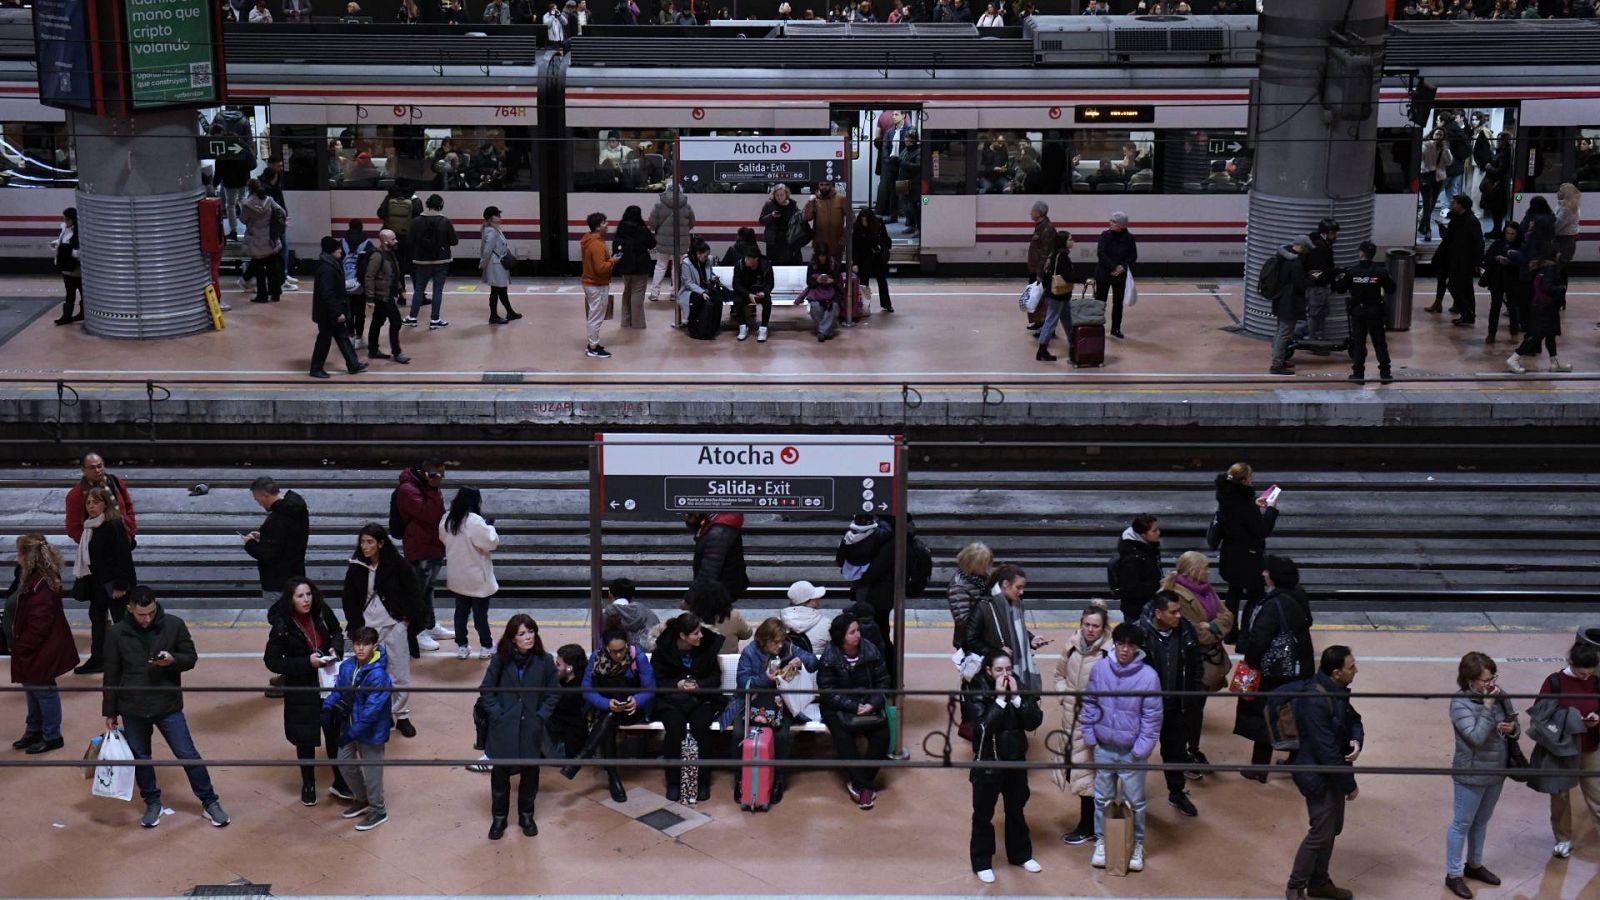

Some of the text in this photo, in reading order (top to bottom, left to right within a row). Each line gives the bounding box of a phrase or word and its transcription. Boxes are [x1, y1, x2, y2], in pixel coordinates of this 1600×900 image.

[132, 7, 200, 22] mano que
[133, 24, 173, 39] cripto
[135, 38, 190, 55] volando
[733, 142, 777, 154] Atocha
[738, 163, 786, 172] Salida Exit
[698, 444, 774, 465] Atocha
[708, 481, 791, 495] Salida Exit
